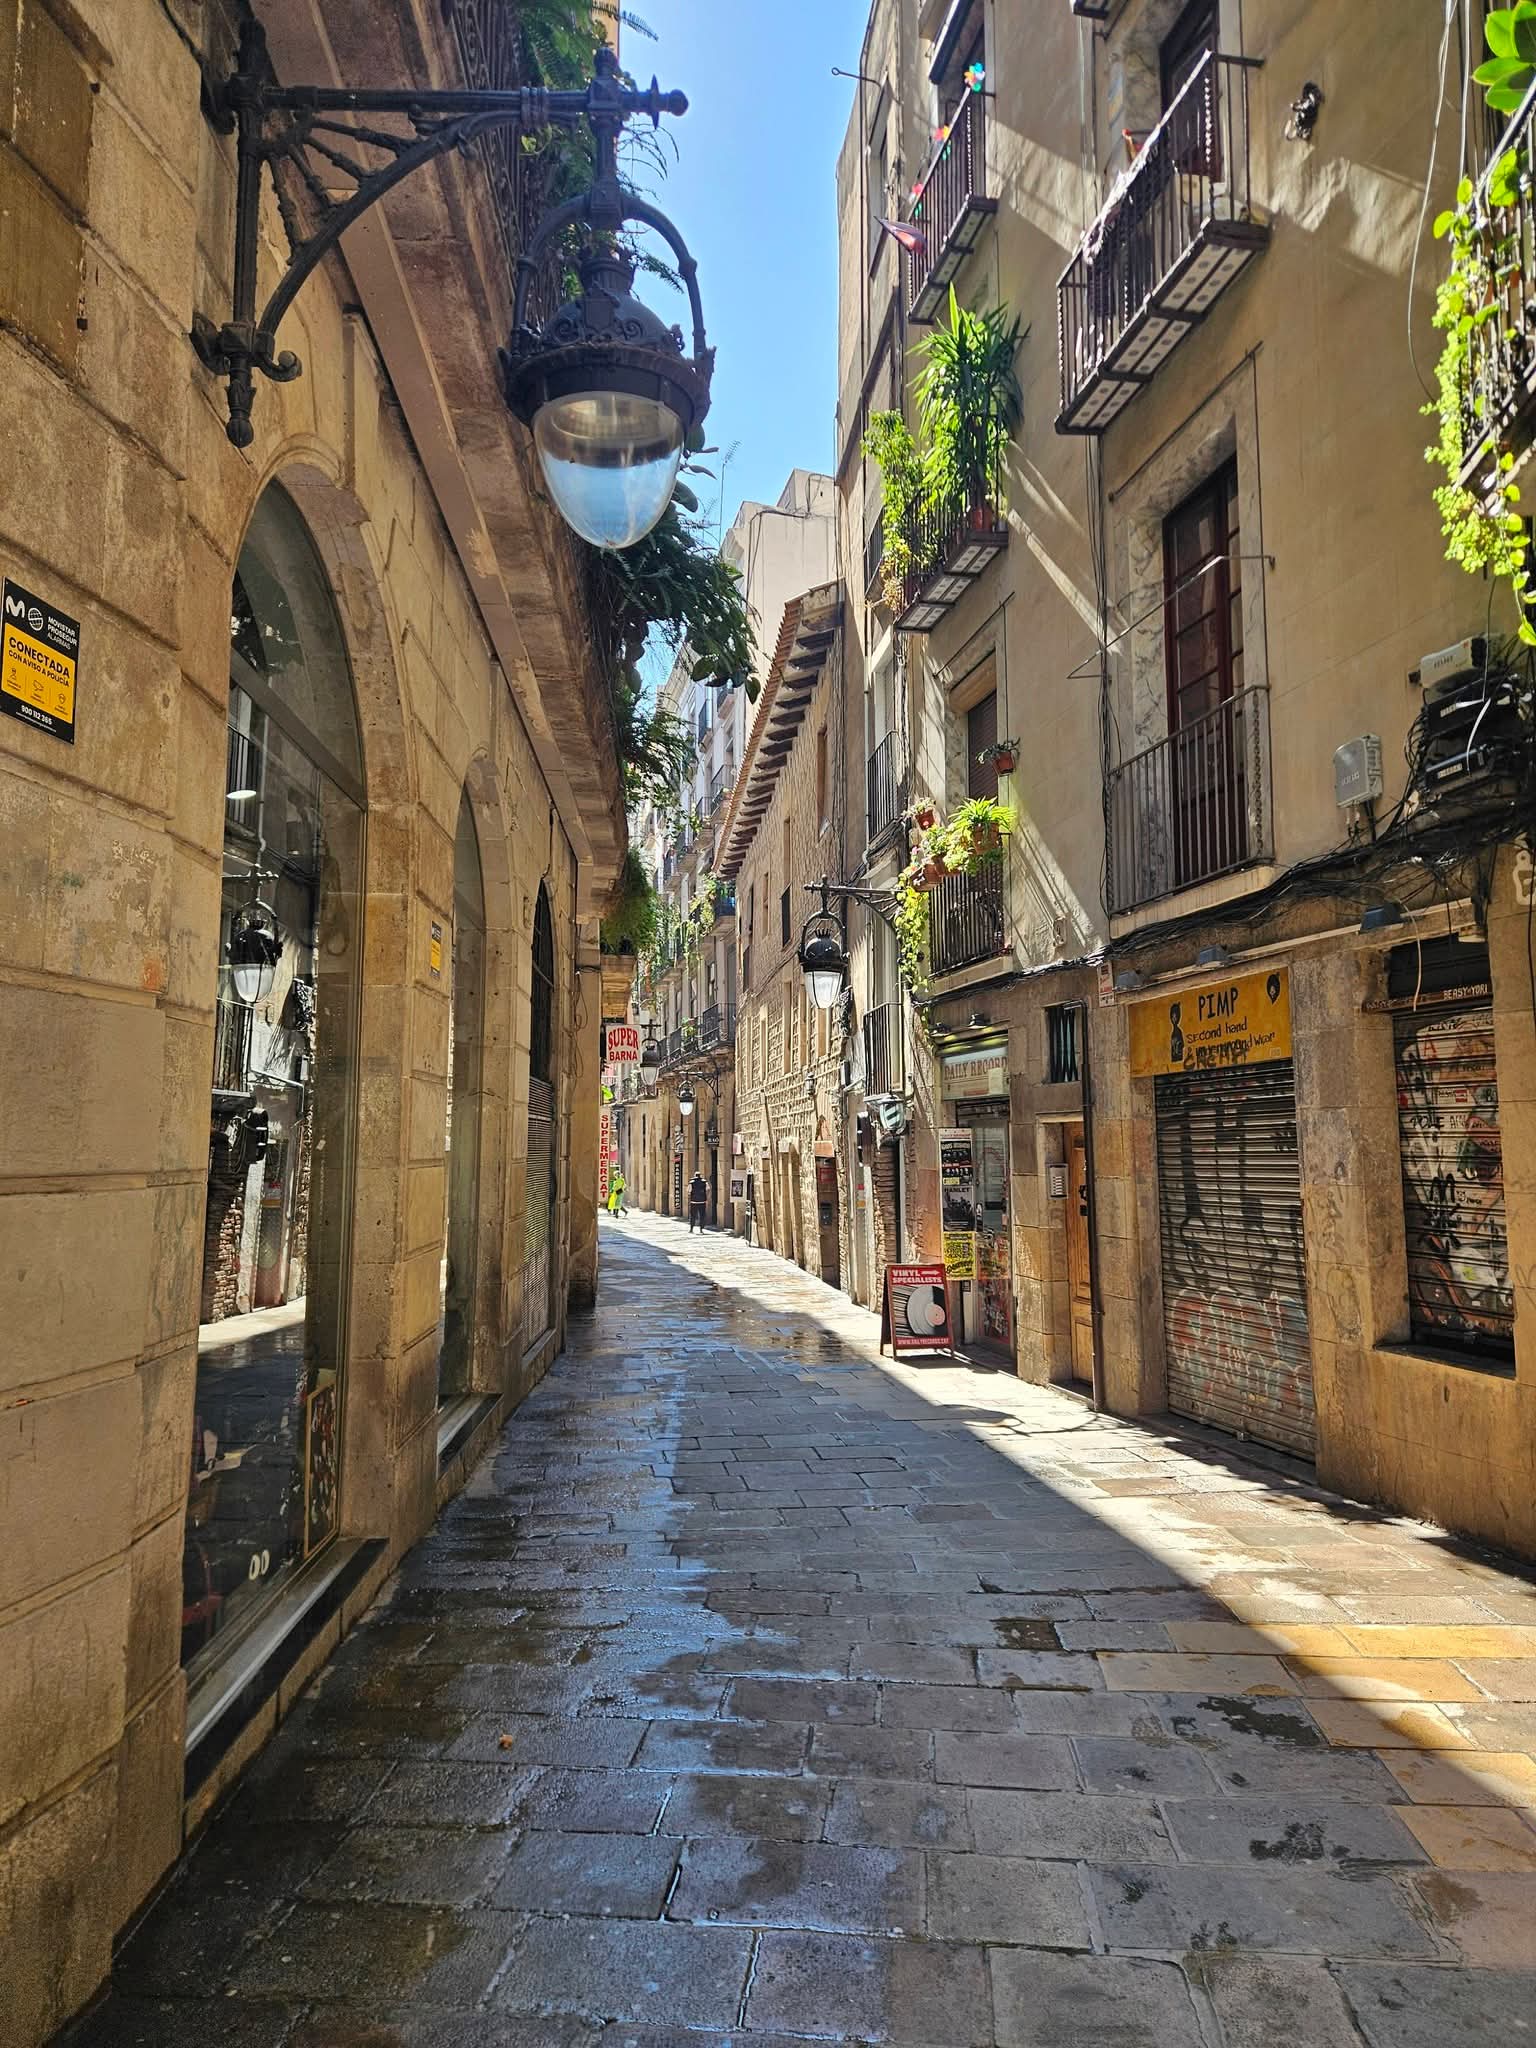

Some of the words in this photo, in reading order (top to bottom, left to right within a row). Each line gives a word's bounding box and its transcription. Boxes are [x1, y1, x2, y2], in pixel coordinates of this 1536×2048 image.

[48, 616, 76, 637] MOVISTAR
[48, 624, 77, 646] PROSEGUR
[9, 636, 70, 679] CONECTADA
[9, 649, 22, 662] CON
[23, 658, 41, 672] AVISO
[1198, 987, 1239, 1022] PIMP
[1225, 1016, 1247, 1033] hand
[608, 1027, 639, 1050] SUPER
[609, 1051, 638, 1061] BARNA
[944, 1062, 969, 1080] DAILY
[600, 1114, 609, 1198] SUPERMERCAT
[892, 1269, 920, 1277] VINYL
